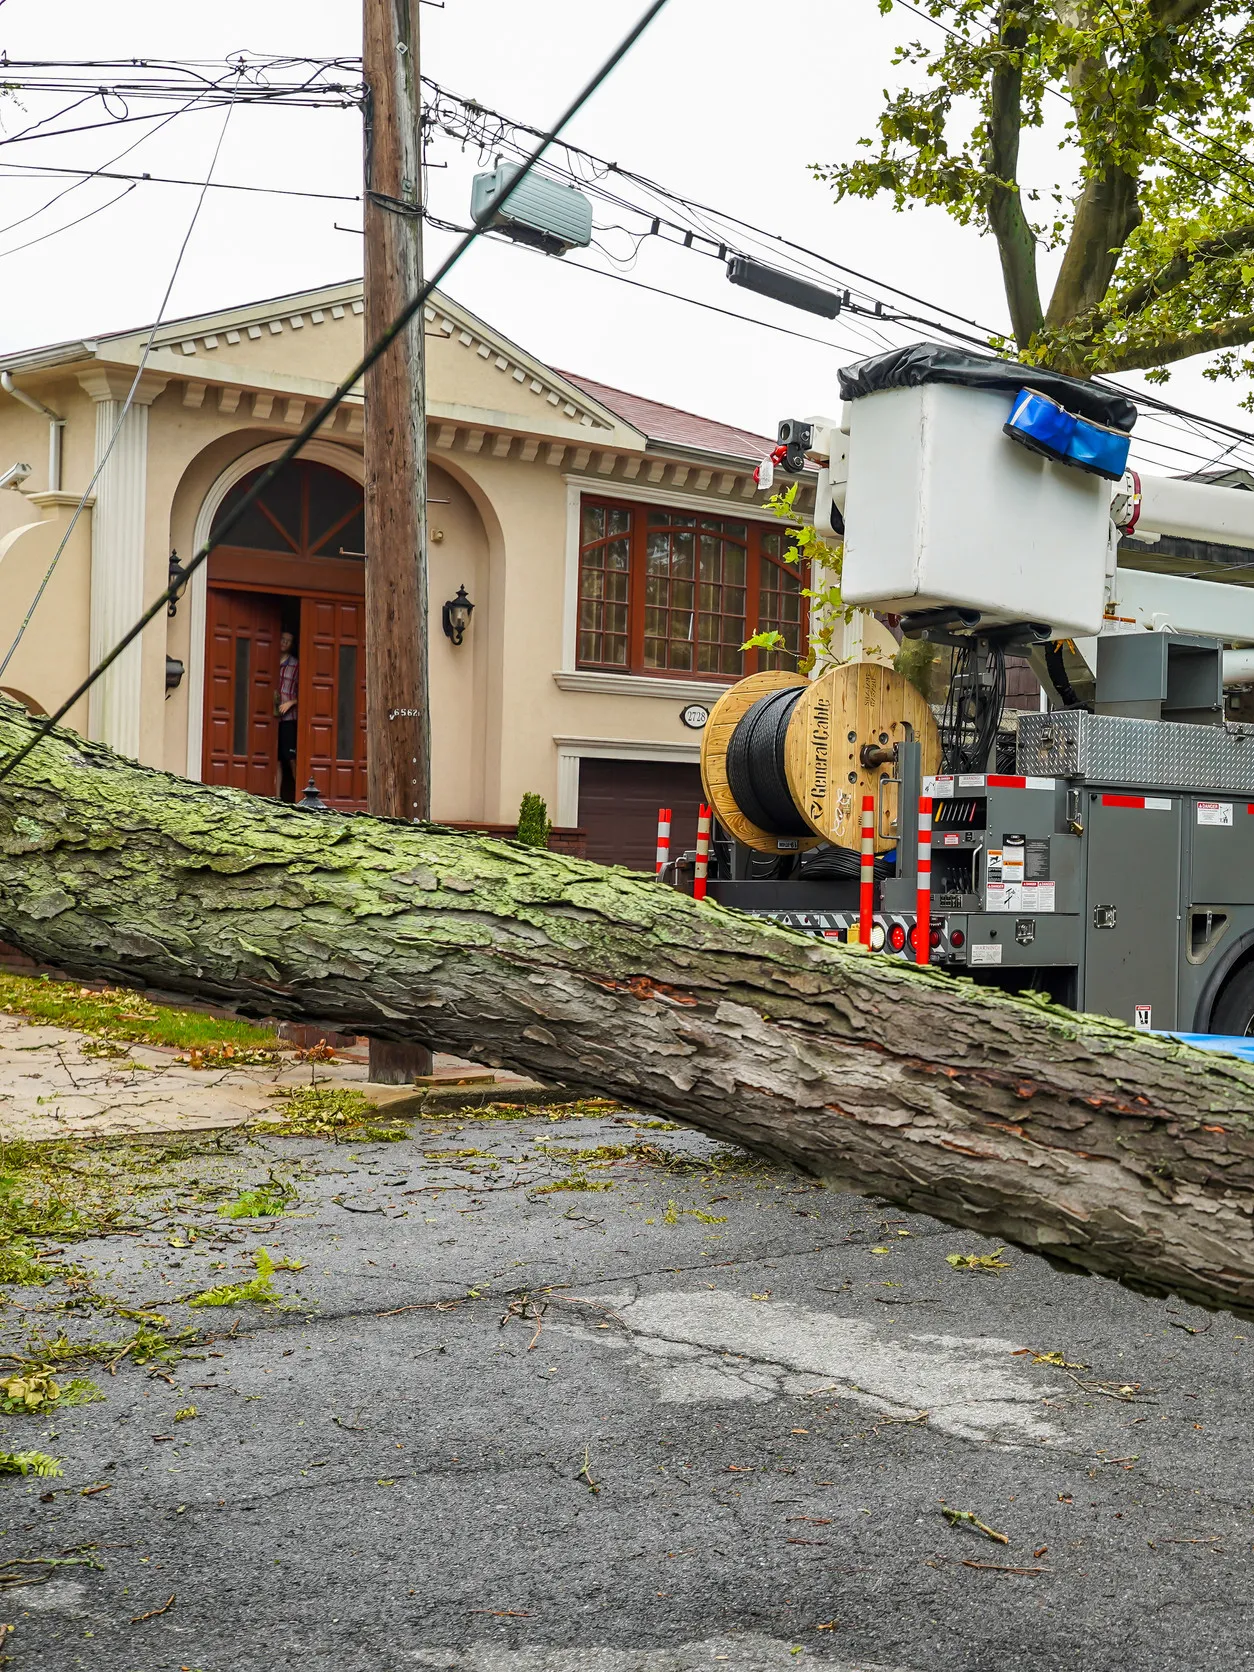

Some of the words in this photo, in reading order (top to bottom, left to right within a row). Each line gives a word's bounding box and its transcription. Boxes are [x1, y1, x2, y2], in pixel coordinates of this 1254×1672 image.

[687, 711, 706, 722] 2728
[811, 698, 831, 740] Cable
[810, 740, 828, 799] General
